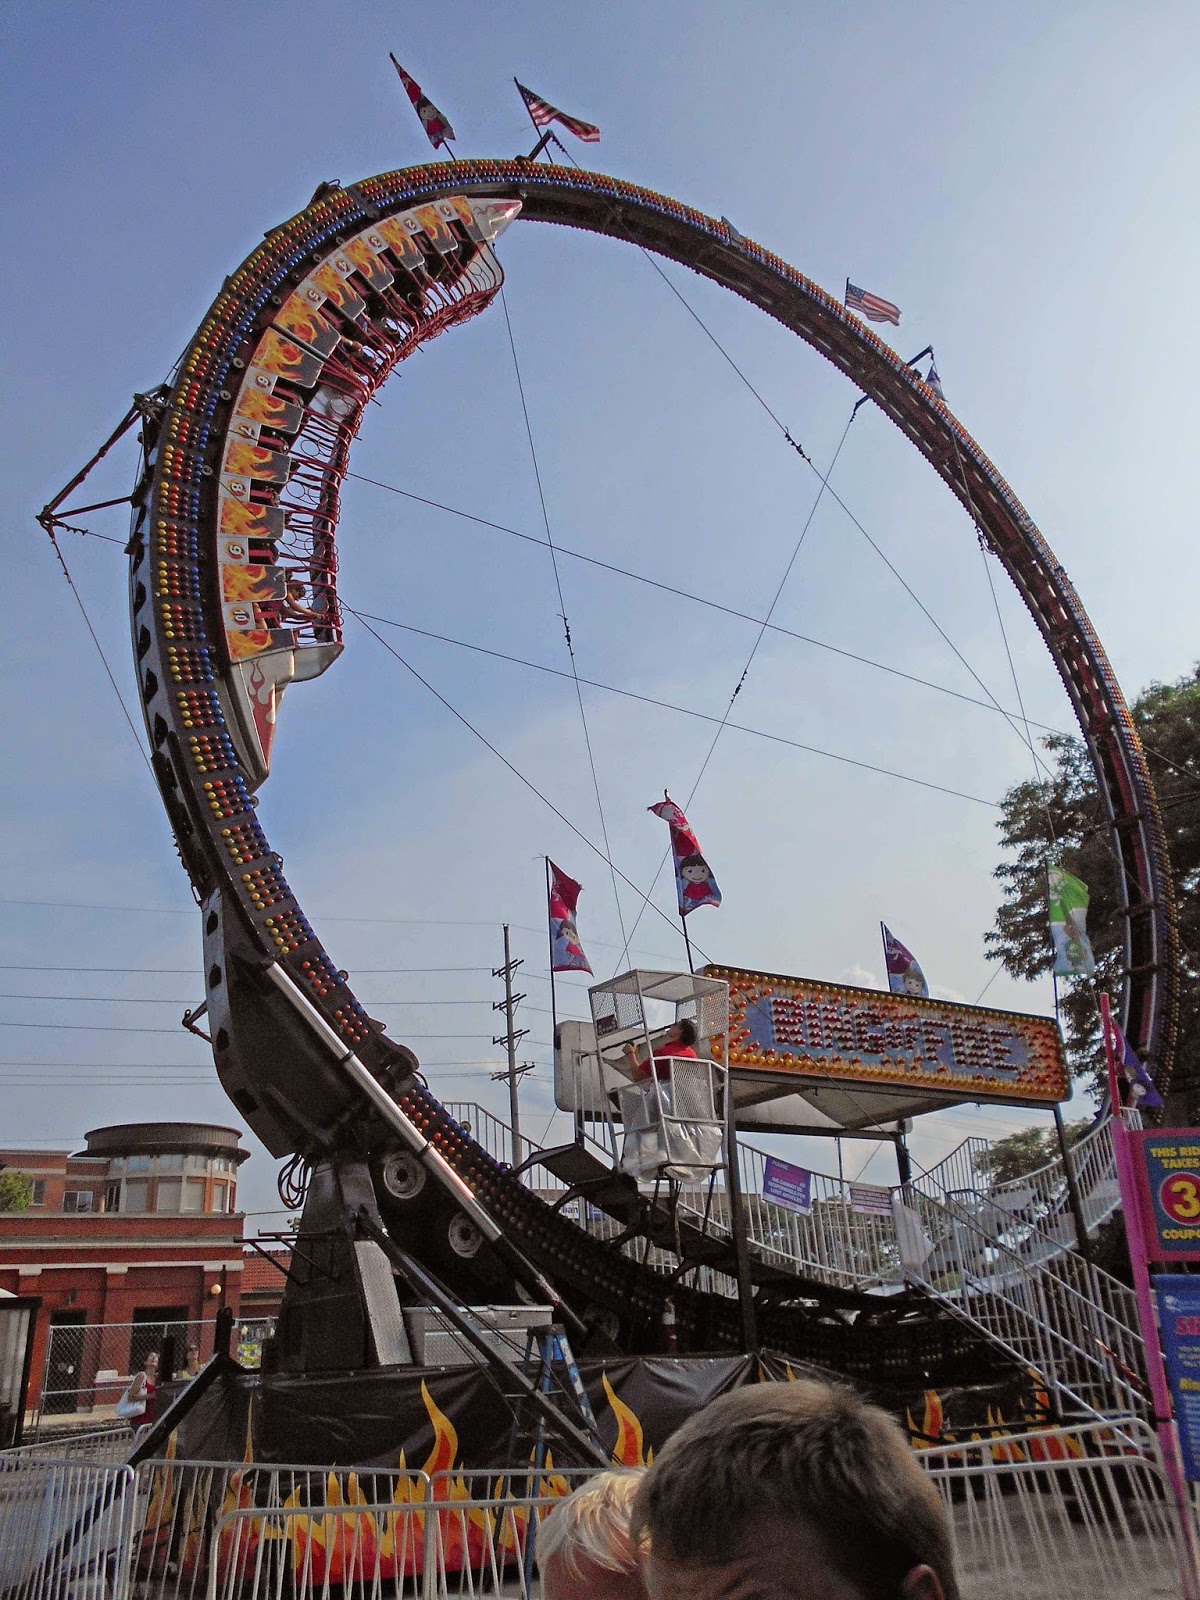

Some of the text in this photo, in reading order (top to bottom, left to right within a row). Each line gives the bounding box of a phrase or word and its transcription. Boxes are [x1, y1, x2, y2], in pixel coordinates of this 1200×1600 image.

[307, 290, 320, 301] 5
[256, 376, 270, 387] 6
[231, 482, 245, 492] 8
[234, 610, 248, 622] 10
[770, 997, 1020, 1072] RING OF FIRE
[1150, 1147, 1177, 1157] THIS
[1161, 1158, 1200, 1169] TAKES
[1171, 1181, 1200, 1218] 3
